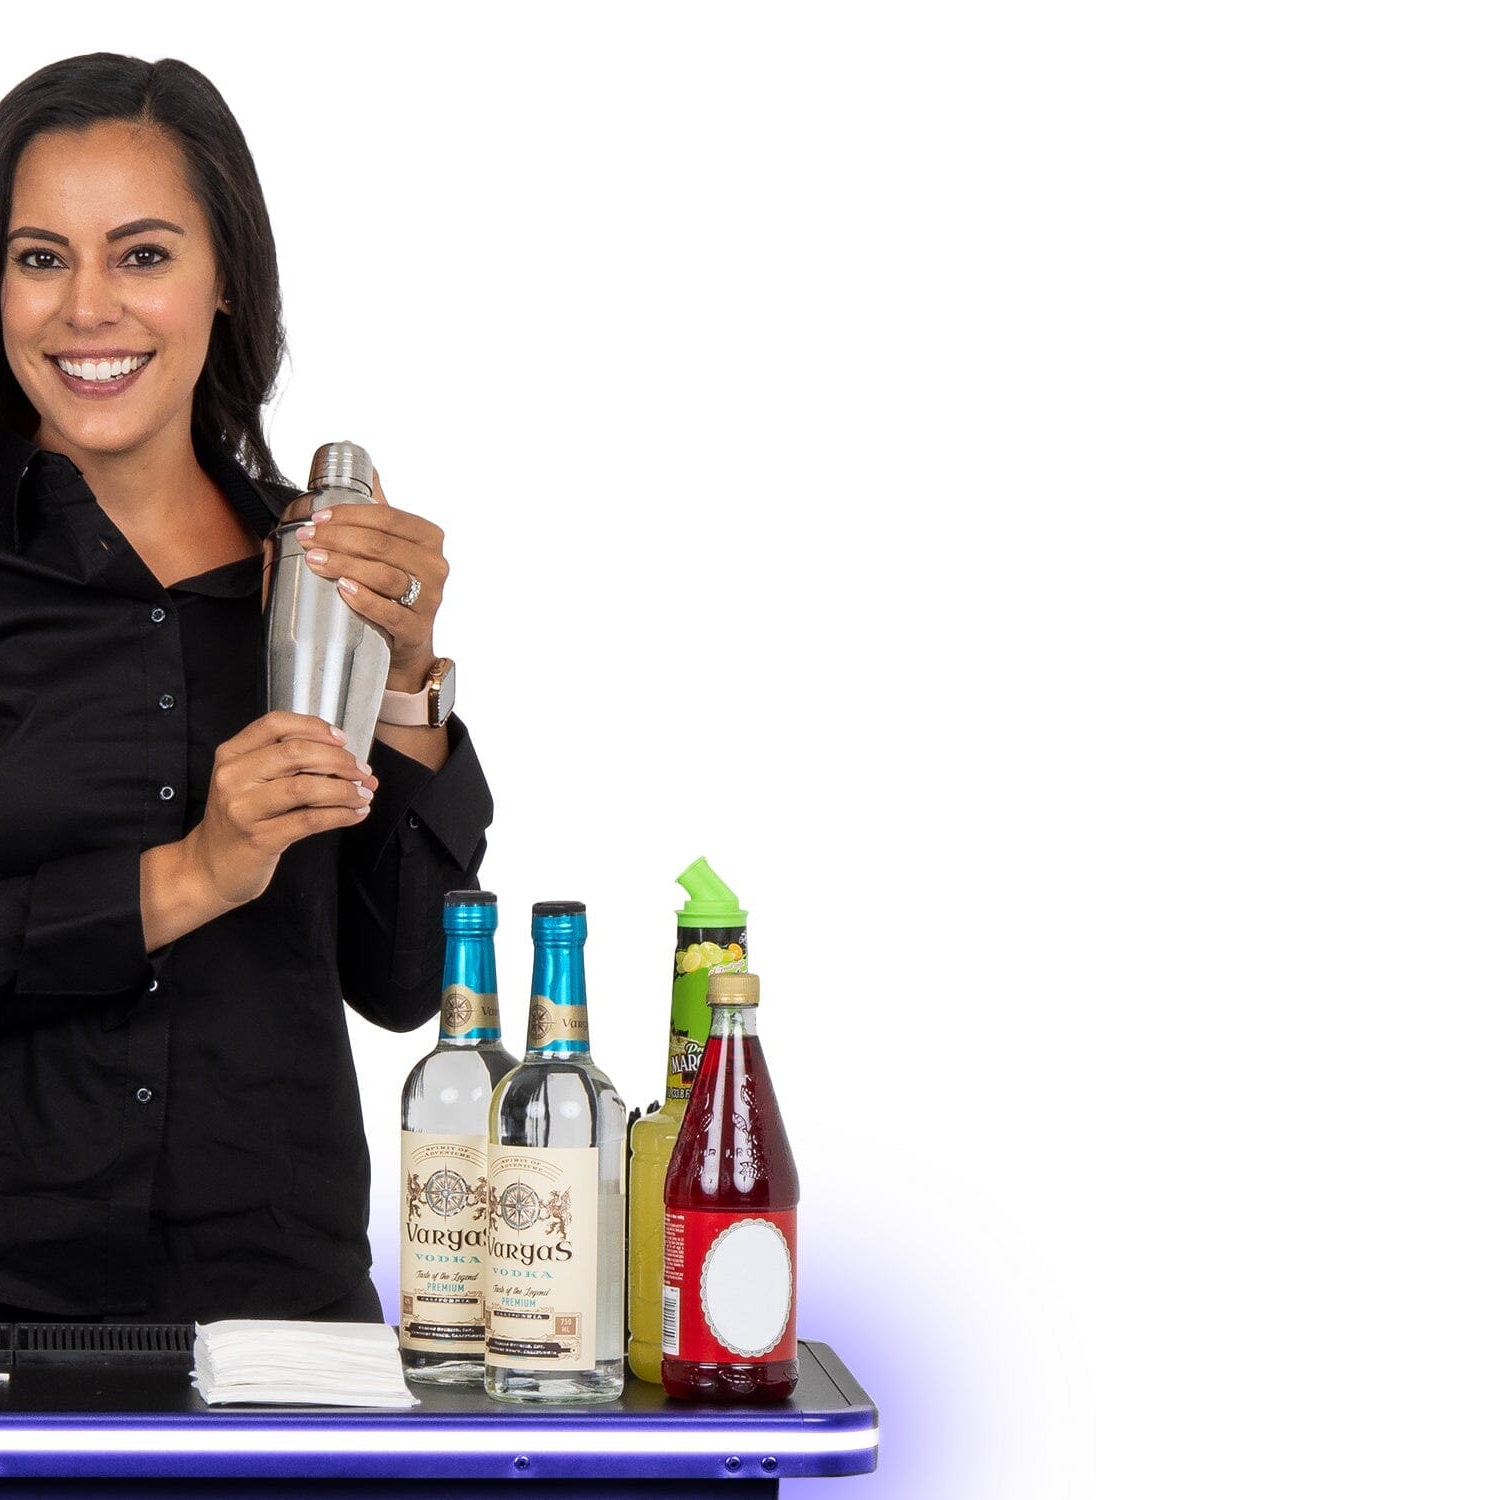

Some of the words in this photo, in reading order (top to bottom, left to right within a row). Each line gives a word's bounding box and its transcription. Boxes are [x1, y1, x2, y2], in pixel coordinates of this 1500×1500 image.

[406, 1222, 487, 1251] Varga
[414, 1253, 482, 1264] VODKA
[415, 1270, 431, 1279] Taste
[431, 1271, 439, 1282] of
[439, 1271, 450, 1281] the
[451, 1271, 479, 1282] Legend
[492, 1266, 554, 1279] VODKA
[427, 1282, 465, 1293] PREMIUM
[492, 1284, 505, 1294] Taste
[505, 1287, 514, 1297] of
[513, 1286, 524, 1296] the
[524, 1287, 552, 1298] Legend
[502, 1297, 537, 1308] PREMIUM
